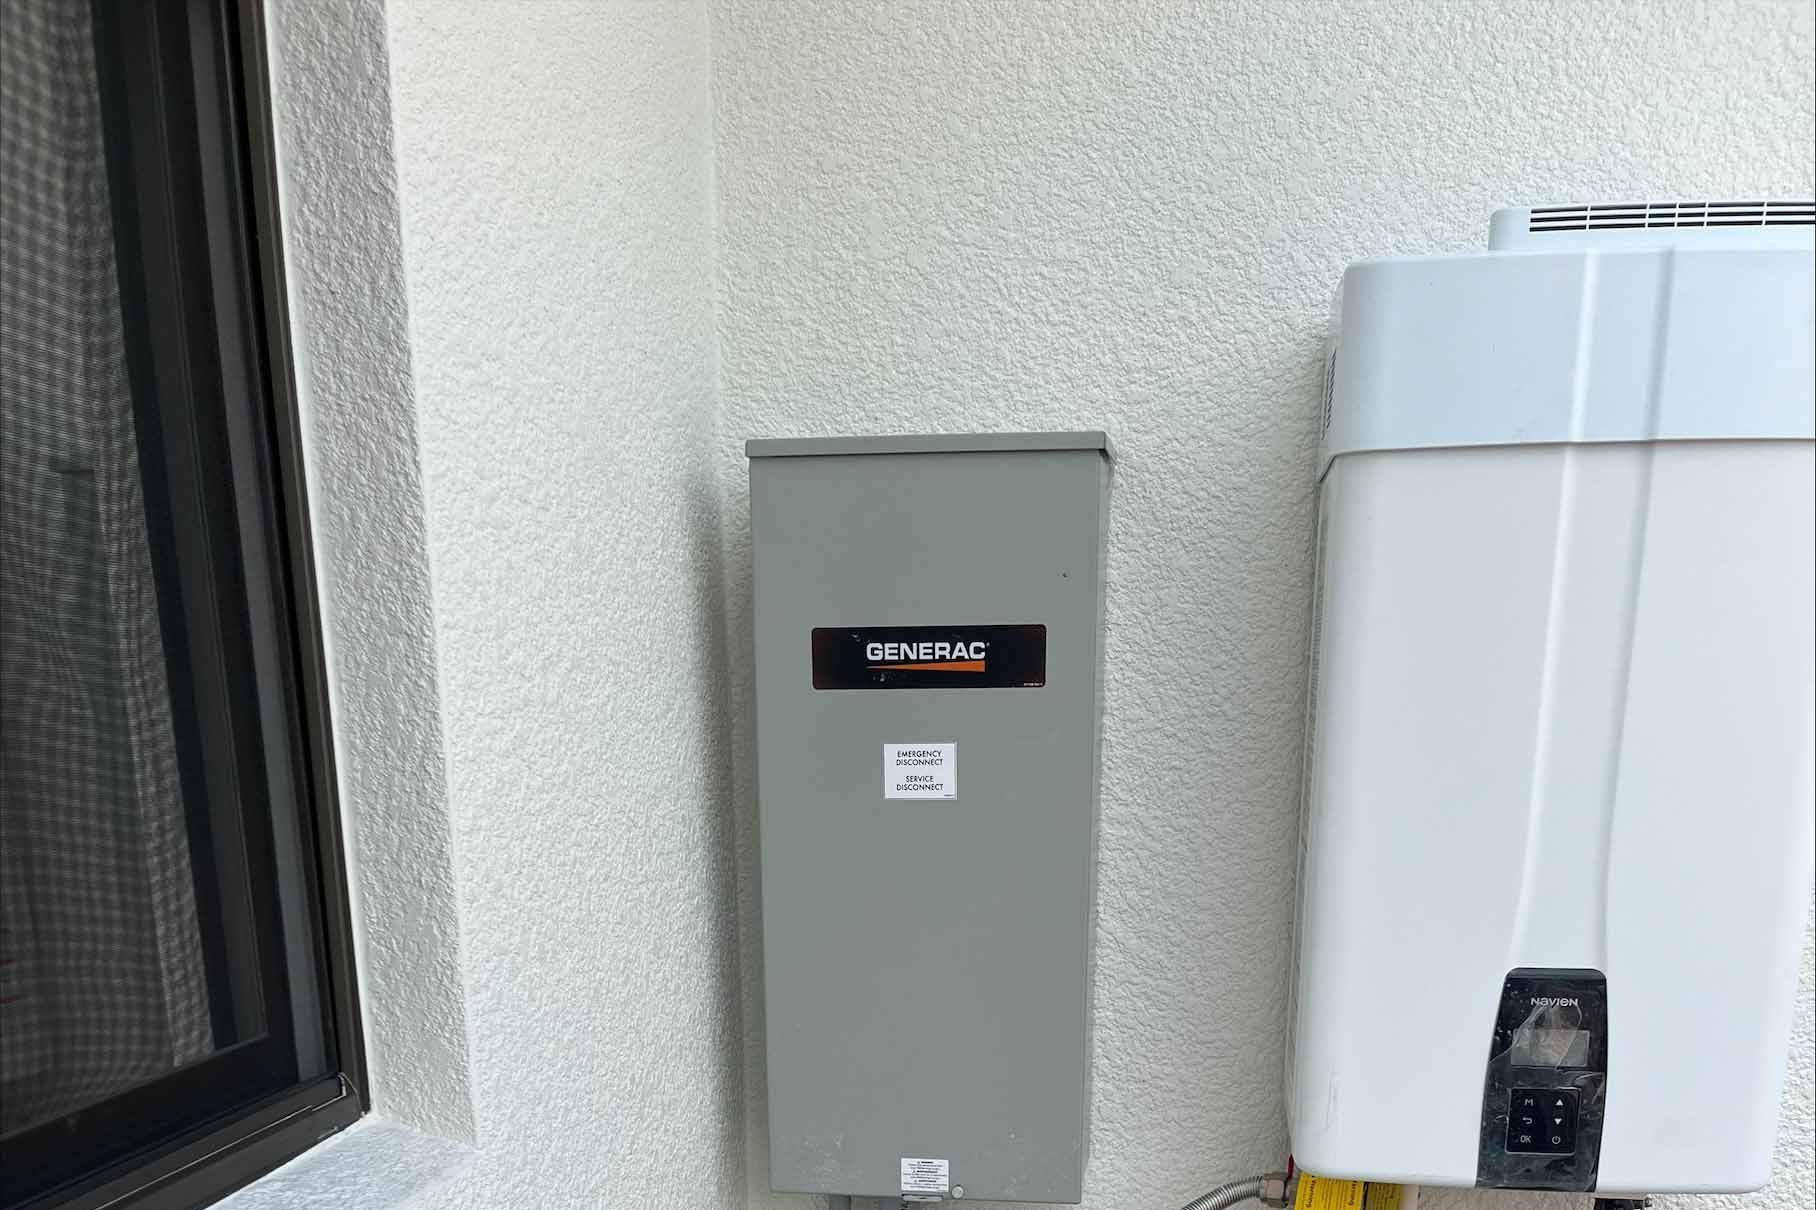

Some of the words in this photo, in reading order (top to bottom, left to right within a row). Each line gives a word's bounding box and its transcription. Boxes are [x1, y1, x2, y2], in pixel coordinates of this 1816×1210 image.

[866, 641, 986, 661] GENERAC
[897, 750, 942, 758] EMERGENCY
[896, 758, 943, 766] DISCONNECT
[905, 775, 934, 783] SERVICE
[896, 783, 943, 791] DISCONNECT
[1520, 1135, 1531, 1143] OK
